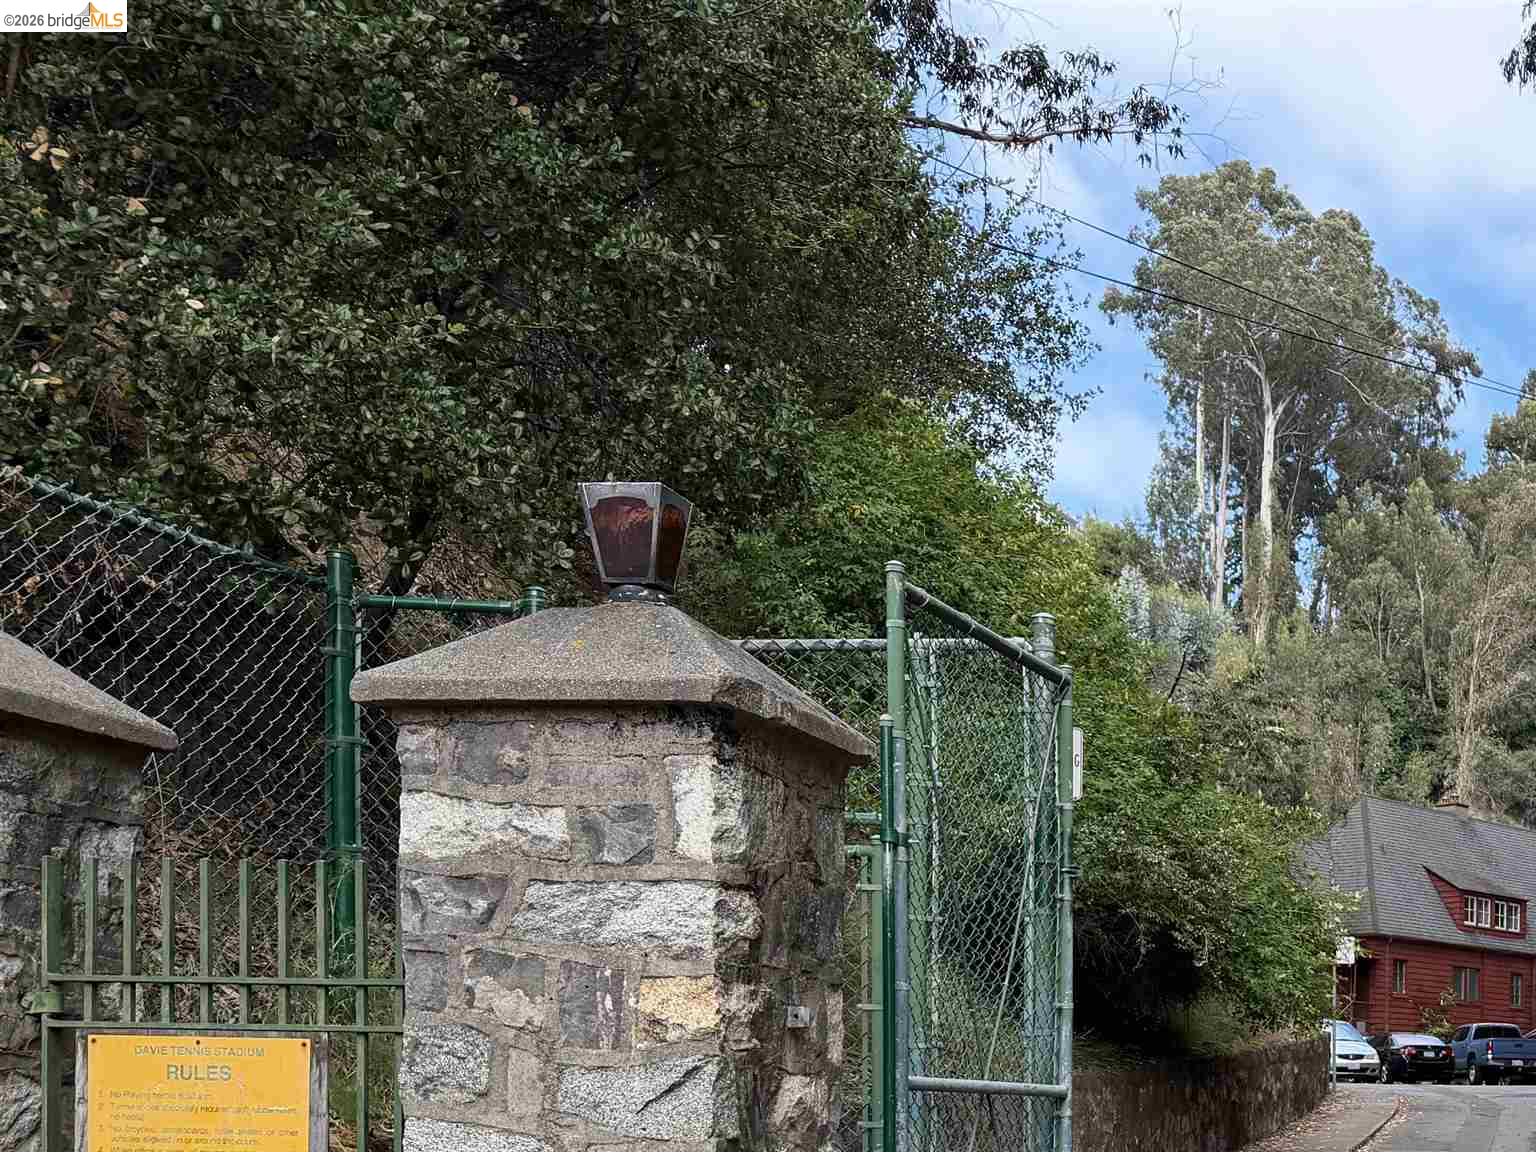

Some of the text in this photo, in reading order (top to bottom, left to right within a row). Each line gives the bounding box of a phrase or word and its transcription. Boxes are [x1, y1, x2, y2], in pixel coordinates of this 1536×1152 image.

[134, 1046, 265, 1057] DAVIE TENNIS STADIUM
[166, 1063, 232, 1081] RULES
